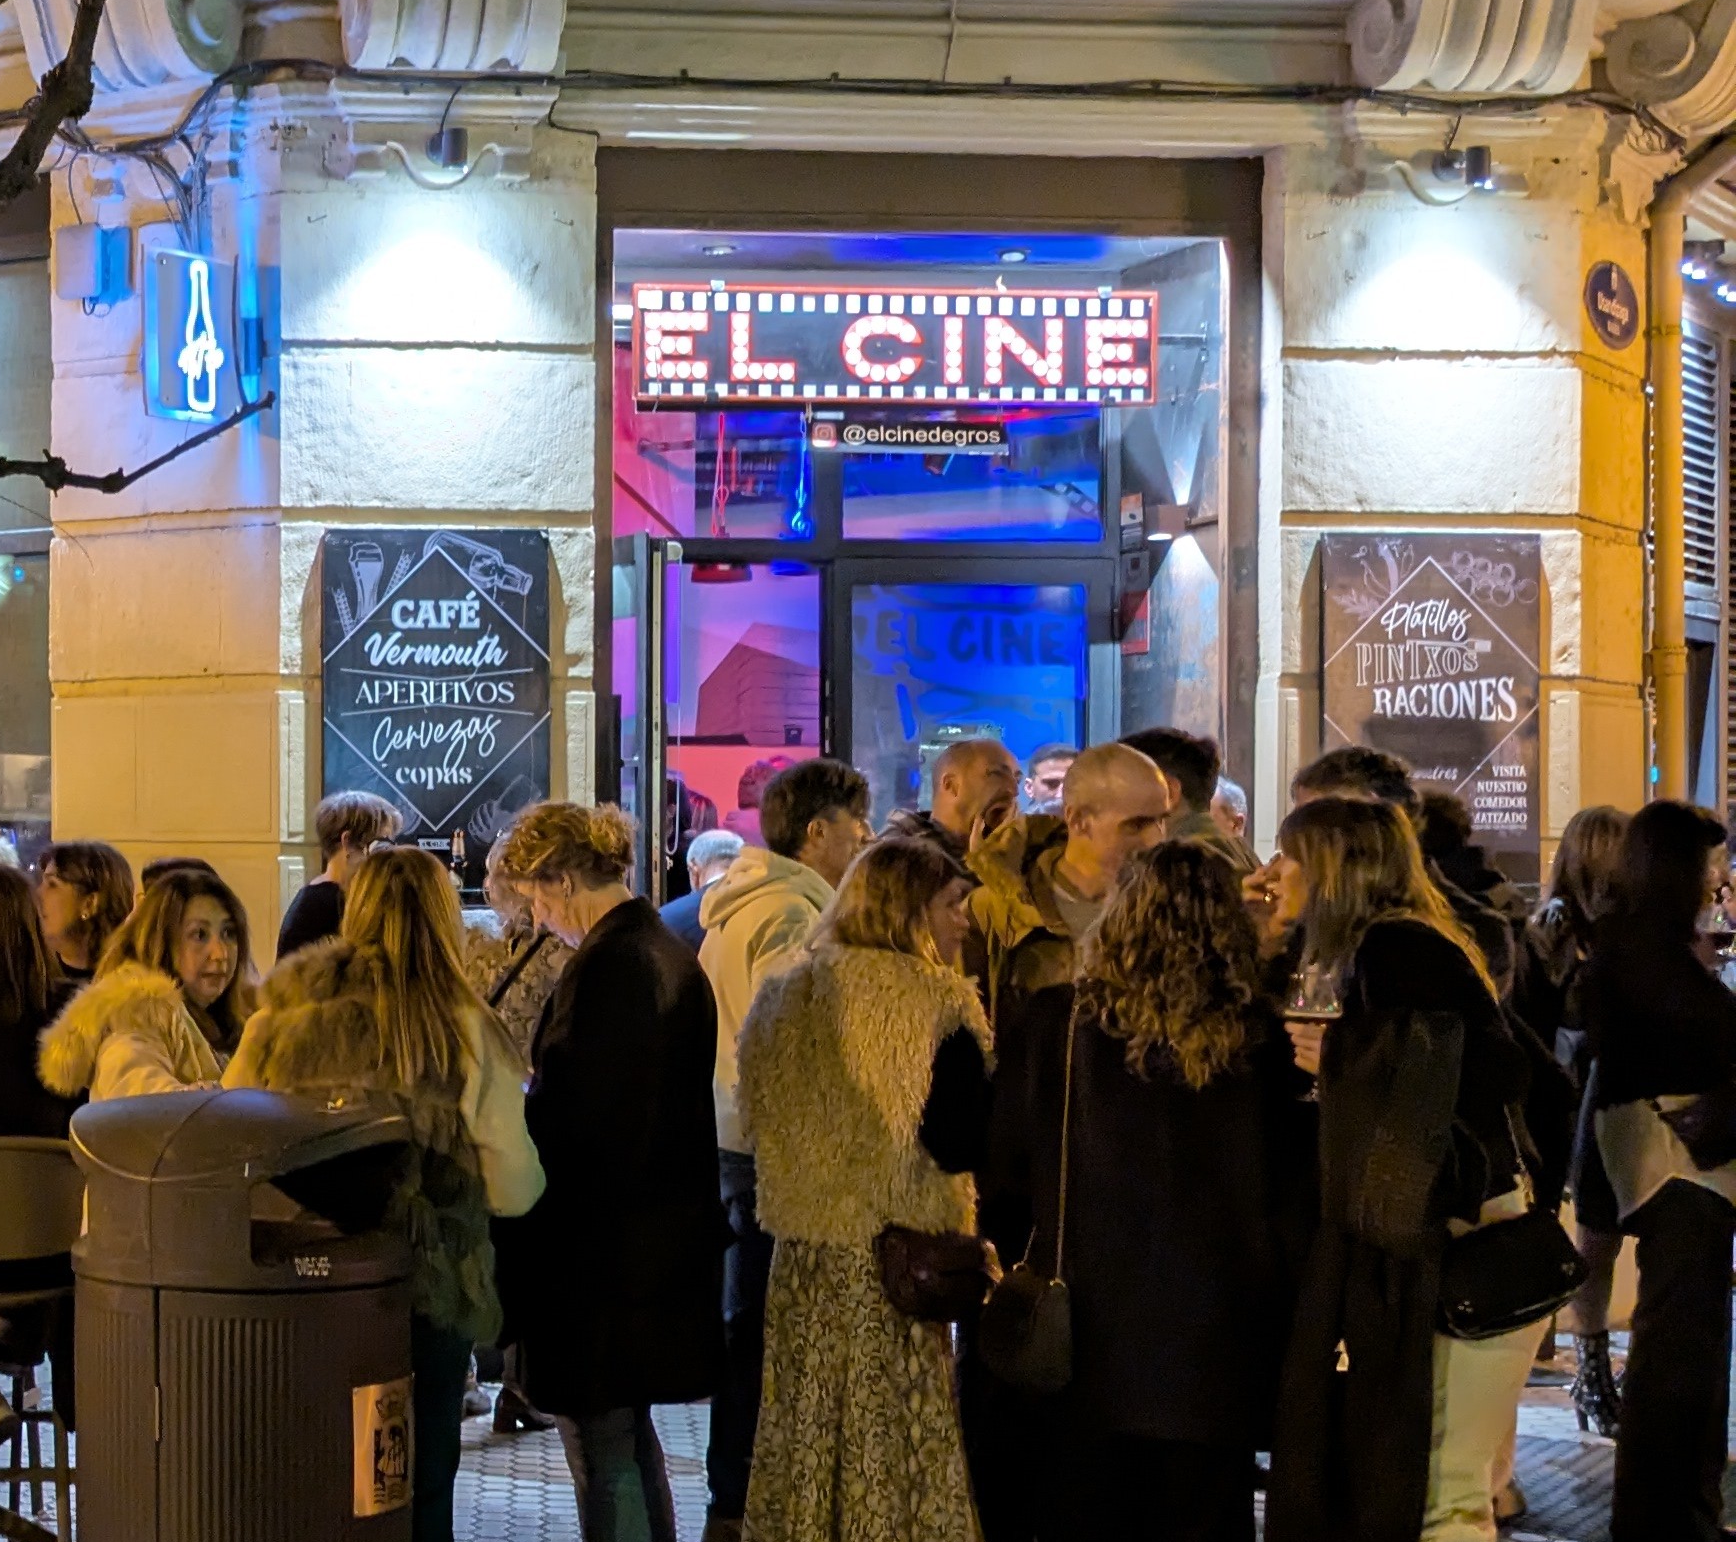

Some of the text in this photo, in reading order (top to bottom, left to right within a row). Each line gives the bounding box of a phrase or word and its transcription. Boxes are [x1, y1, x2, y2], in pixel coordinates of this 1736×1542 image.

[644, 310, 1149, 387] EL CINE
[843, 425, 1001, 447] @elcinedegros
[391, 590, 481, 629] CAFÉ
[1380, 599, 1472, 641] Platillos
[364, 631, 509, 667] Vermouth
[1356, 638, 1480, 687] PINTXOS
[355, 680, 515, 705] APERITIVOS
[1373, 676, 1518, 723] RACIONES
[372, 713, 502, 773] Cervezas
[395, 764, 473, 790] copas
[1476, 780, 1528, 793] NUESTRO
[1492, 765, 1527, 778] VISITA
[1473, 796, 1527, 809] COMEDOR
